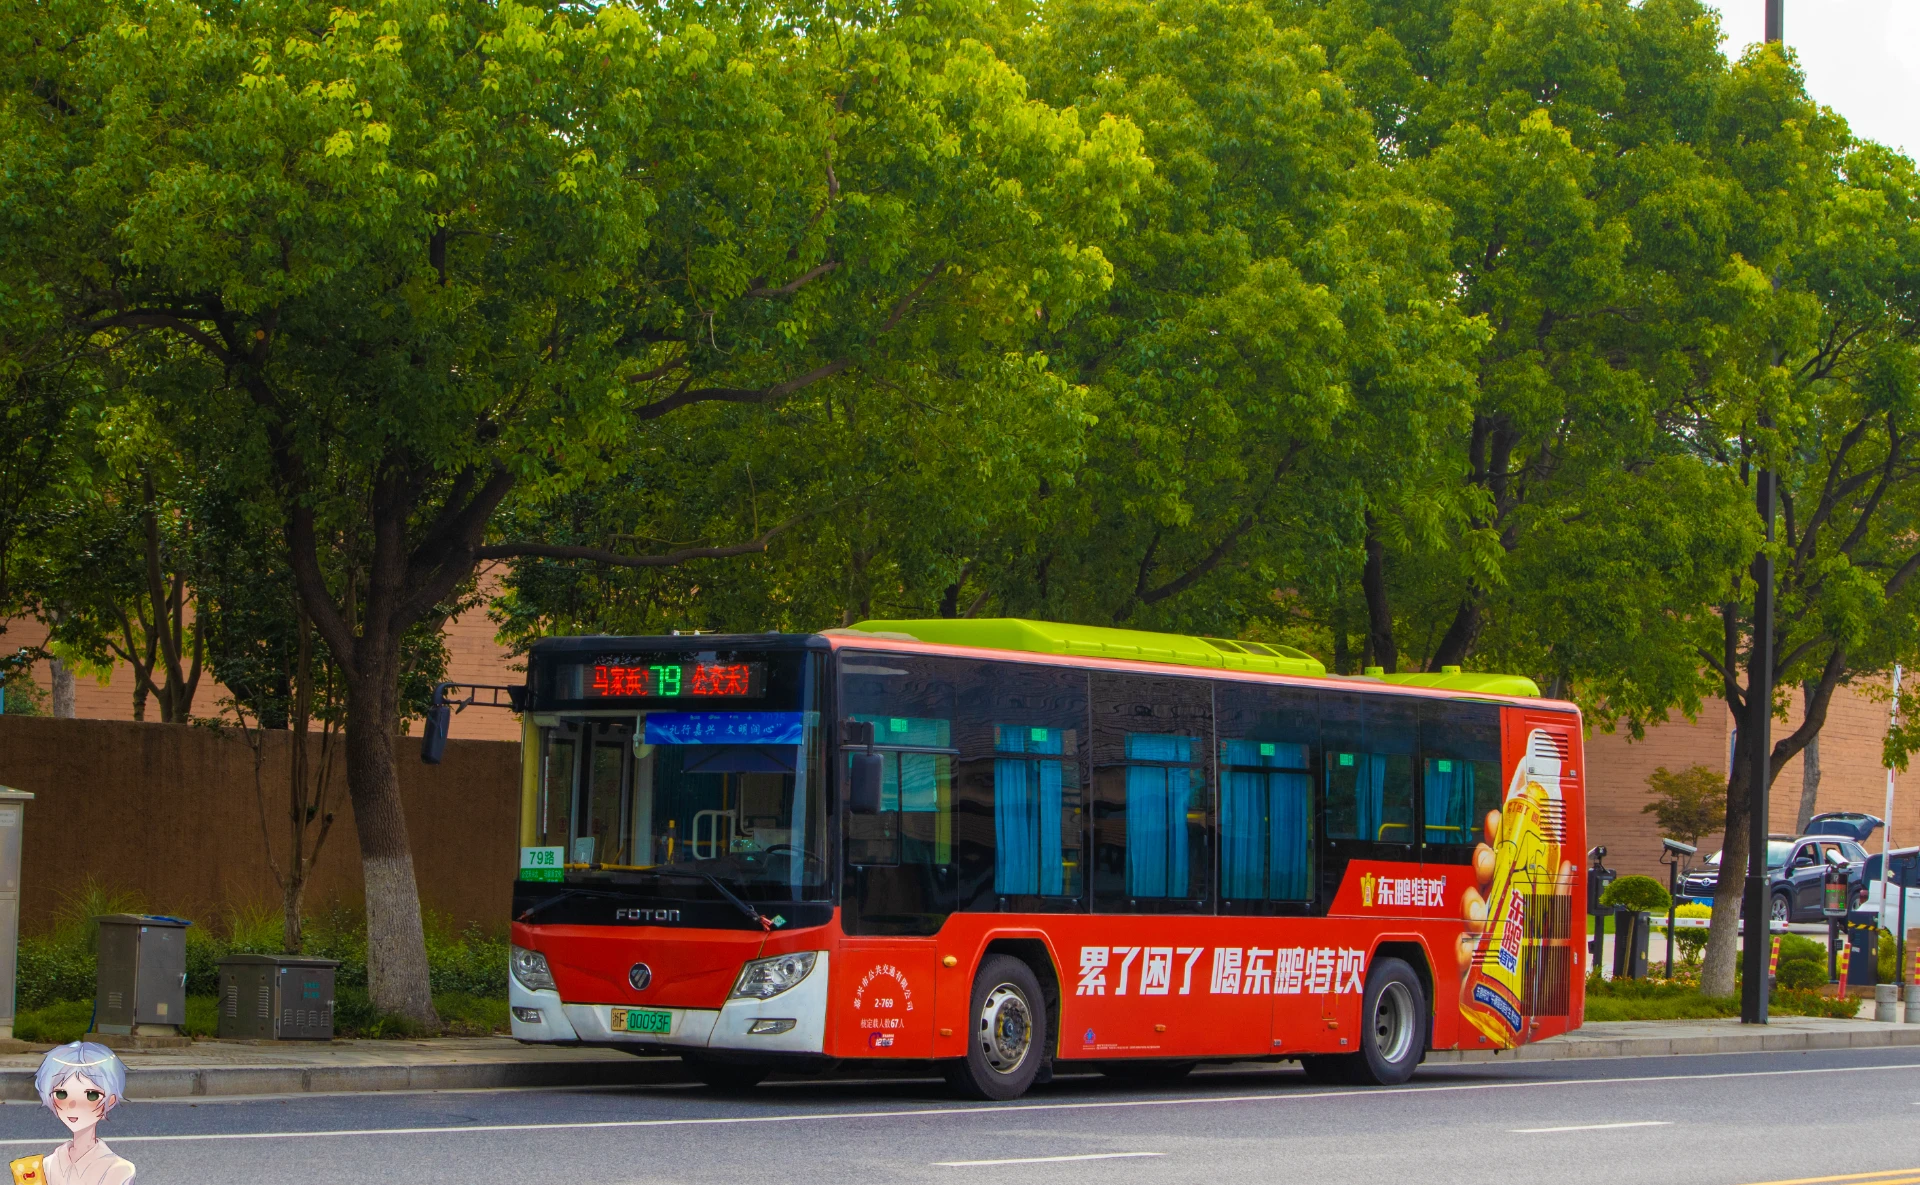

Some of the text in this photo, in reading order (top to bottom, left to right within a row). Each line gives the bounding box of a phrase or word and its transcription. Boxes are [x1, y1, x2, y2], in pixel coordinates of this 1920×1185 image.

[650, 665, 681, 696] 79
[529, 851, 555, 865] 79路
[1377, 876, 1444, 907] 东鹏特饮
[616, 908, 680, 922] FOTON
[1076, 946, 1365, 996] 累了困了 喝东鹏特饮
[874, 998, 894, 1008] 2-769
